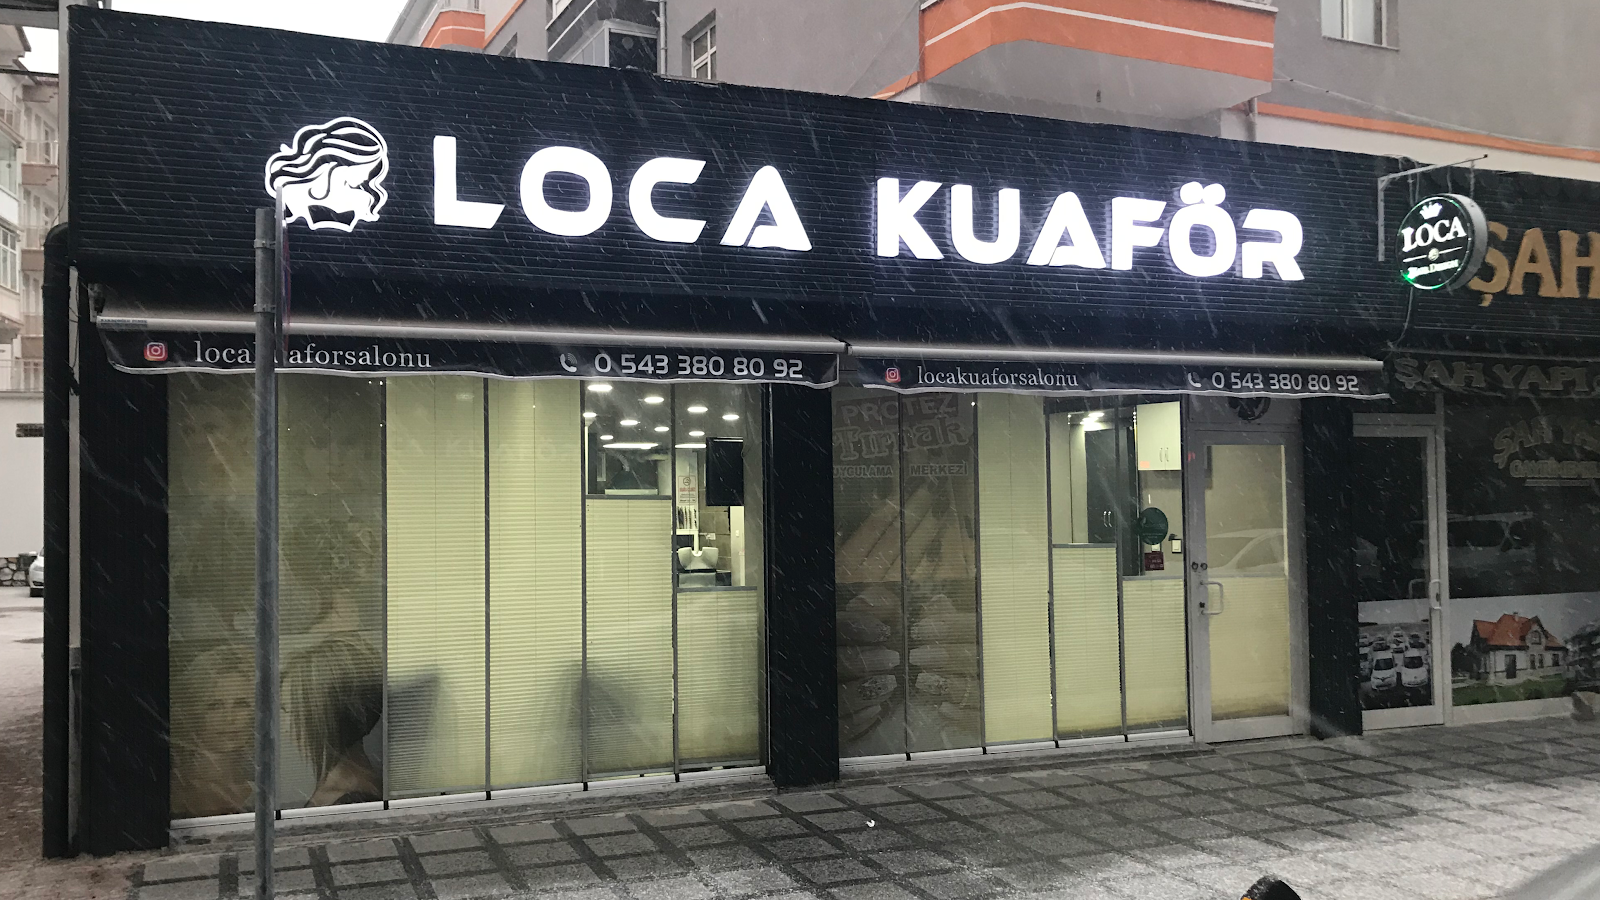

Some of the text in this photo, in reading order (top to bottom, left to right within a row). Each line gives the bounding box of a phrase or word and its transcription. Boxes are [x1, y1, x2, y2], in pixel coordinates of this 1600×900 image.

[433, 135, 1305, 281] LOCA KUAFÖR
[1401, 216, 1468, 253] LOCA
[194, 341, 432, 368] locaaforsalonu
[594, 353, 804, 379] 0 543 380 80 92
[917, 366, 1079, 387] locakuaforsalonu
[1211, 372, 1360, 392] 0 543 380 80 92
[1492, 363, 1590, 392] YAPI
[841, 394, 958, 424] PROTEZ
